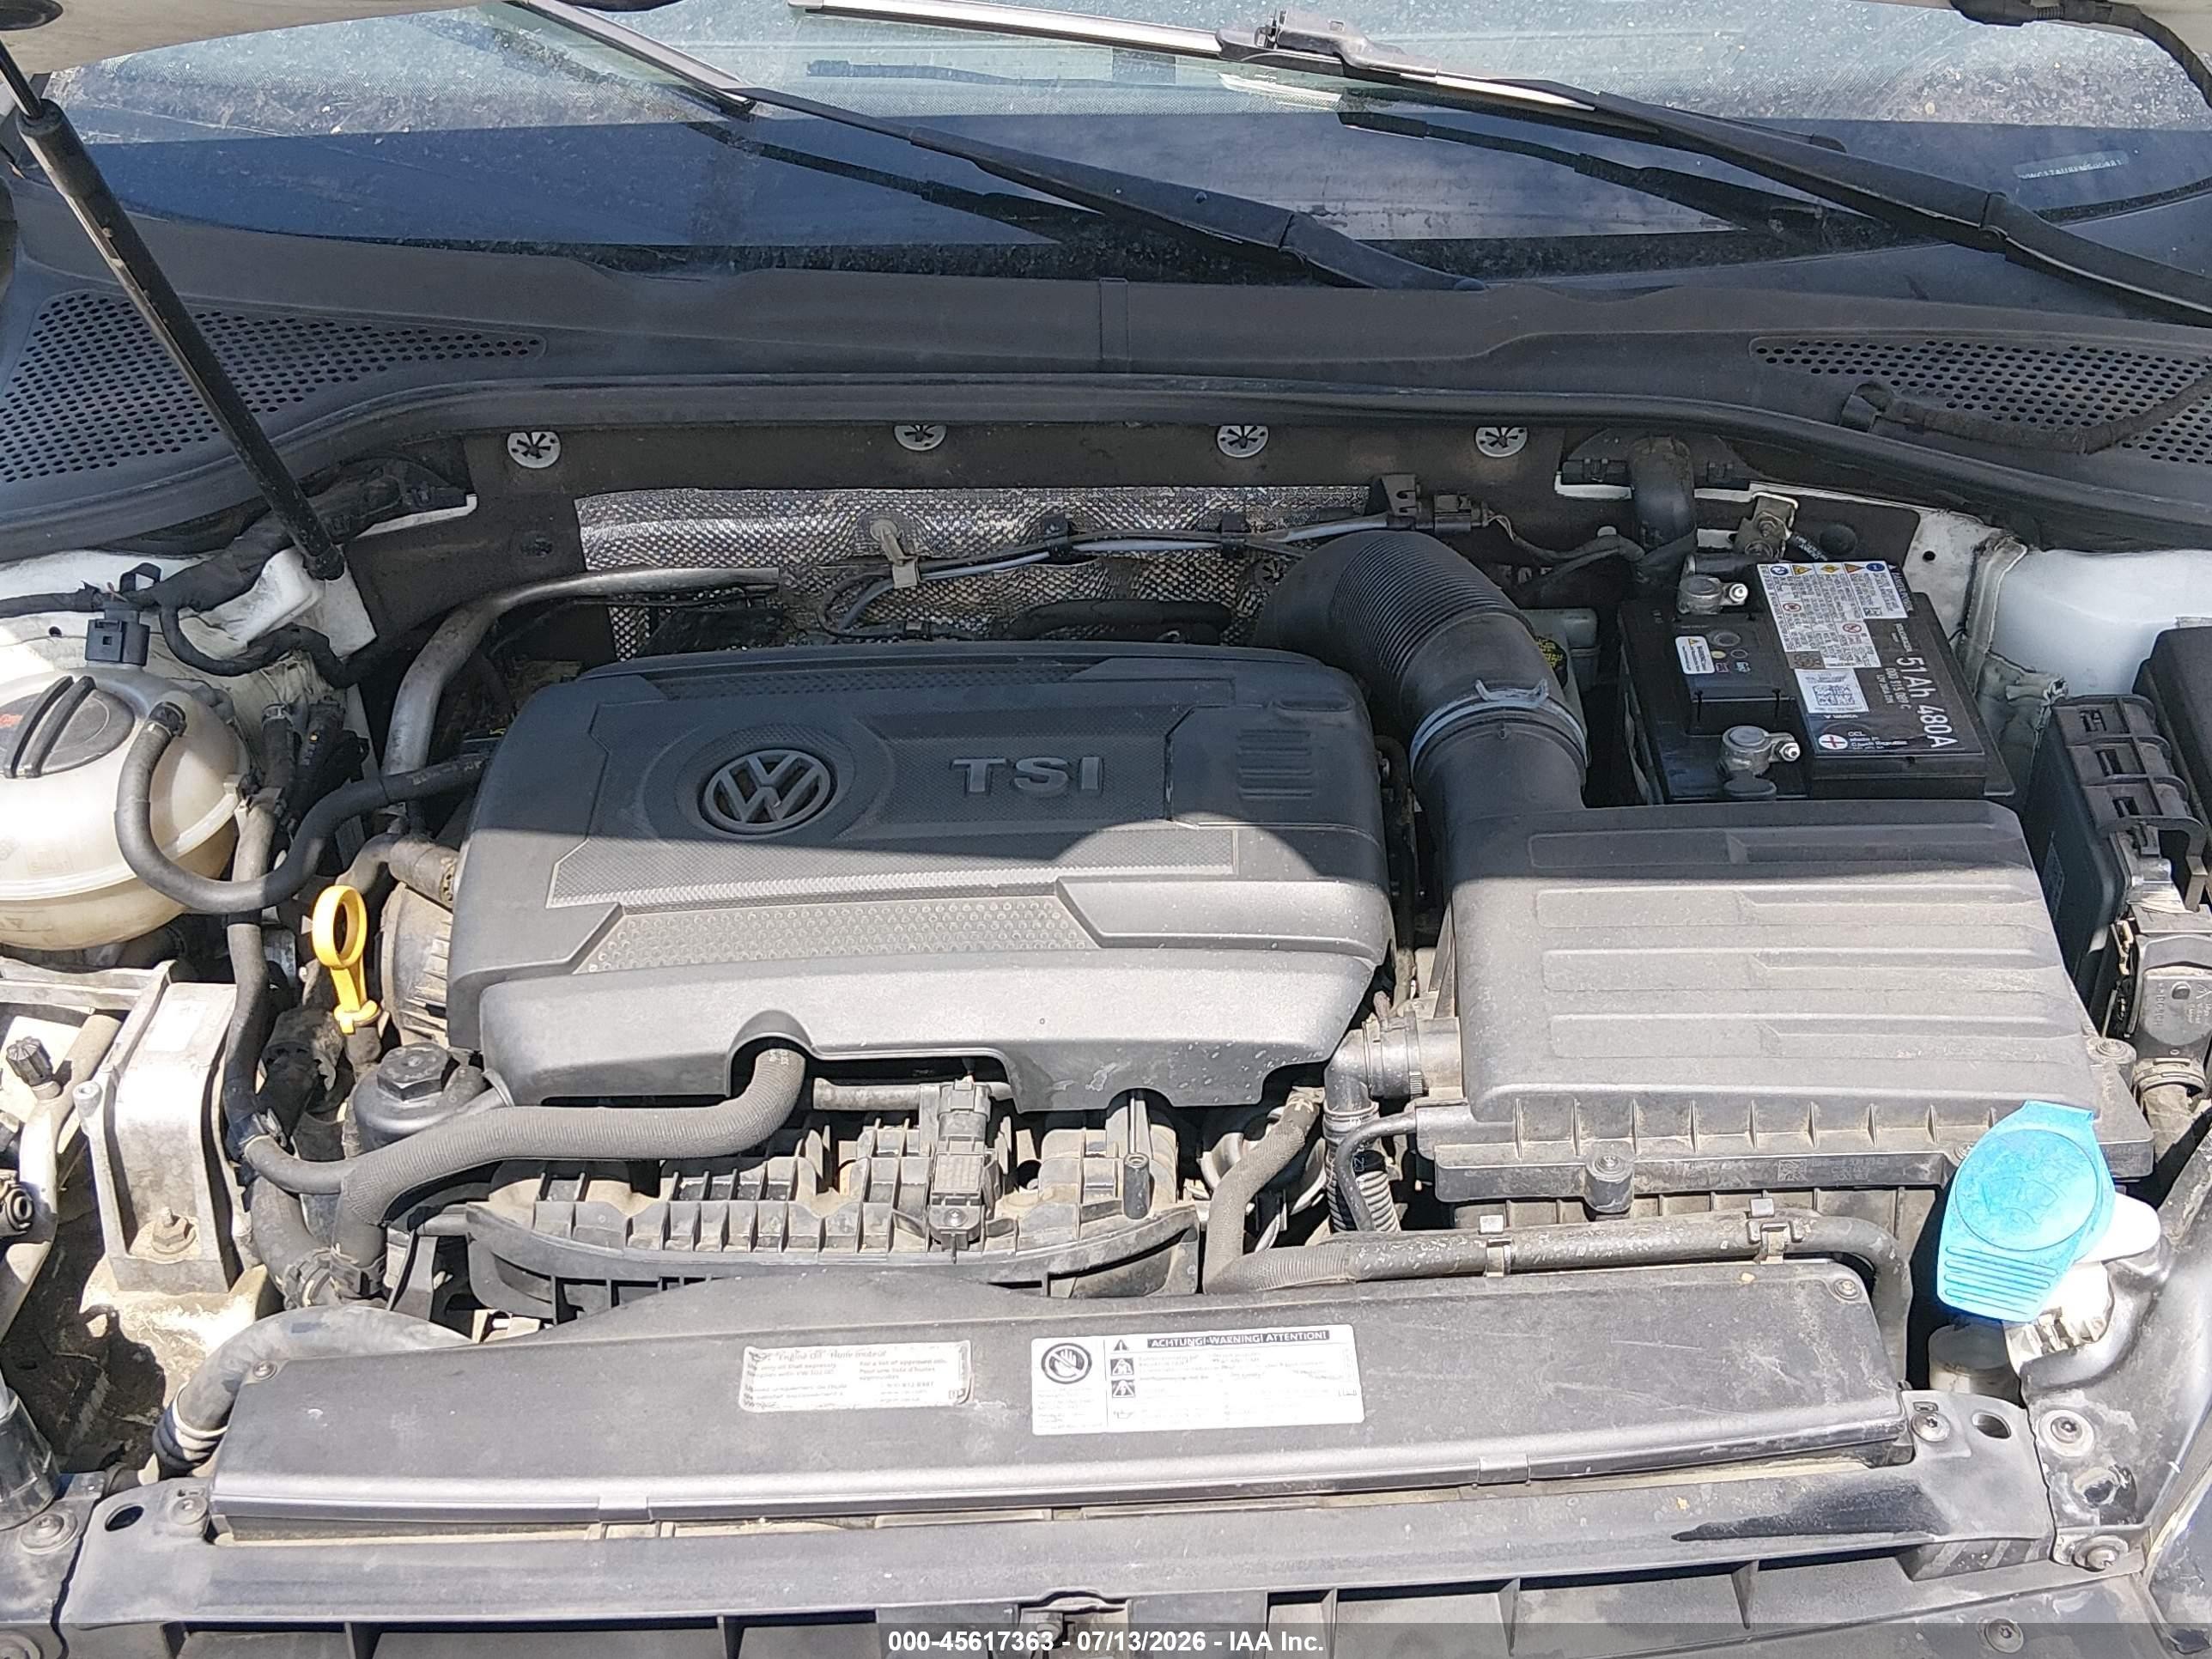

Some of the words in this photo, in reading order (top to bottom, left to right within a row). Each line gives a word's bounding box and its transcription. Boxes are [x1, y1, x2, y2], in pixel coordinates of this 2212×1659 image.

[1916, 705, 1958, 748] 480A
[951, 755, 1103, 795] TSI
[1266, 1331, 1327, 1341] ATTENTION!
